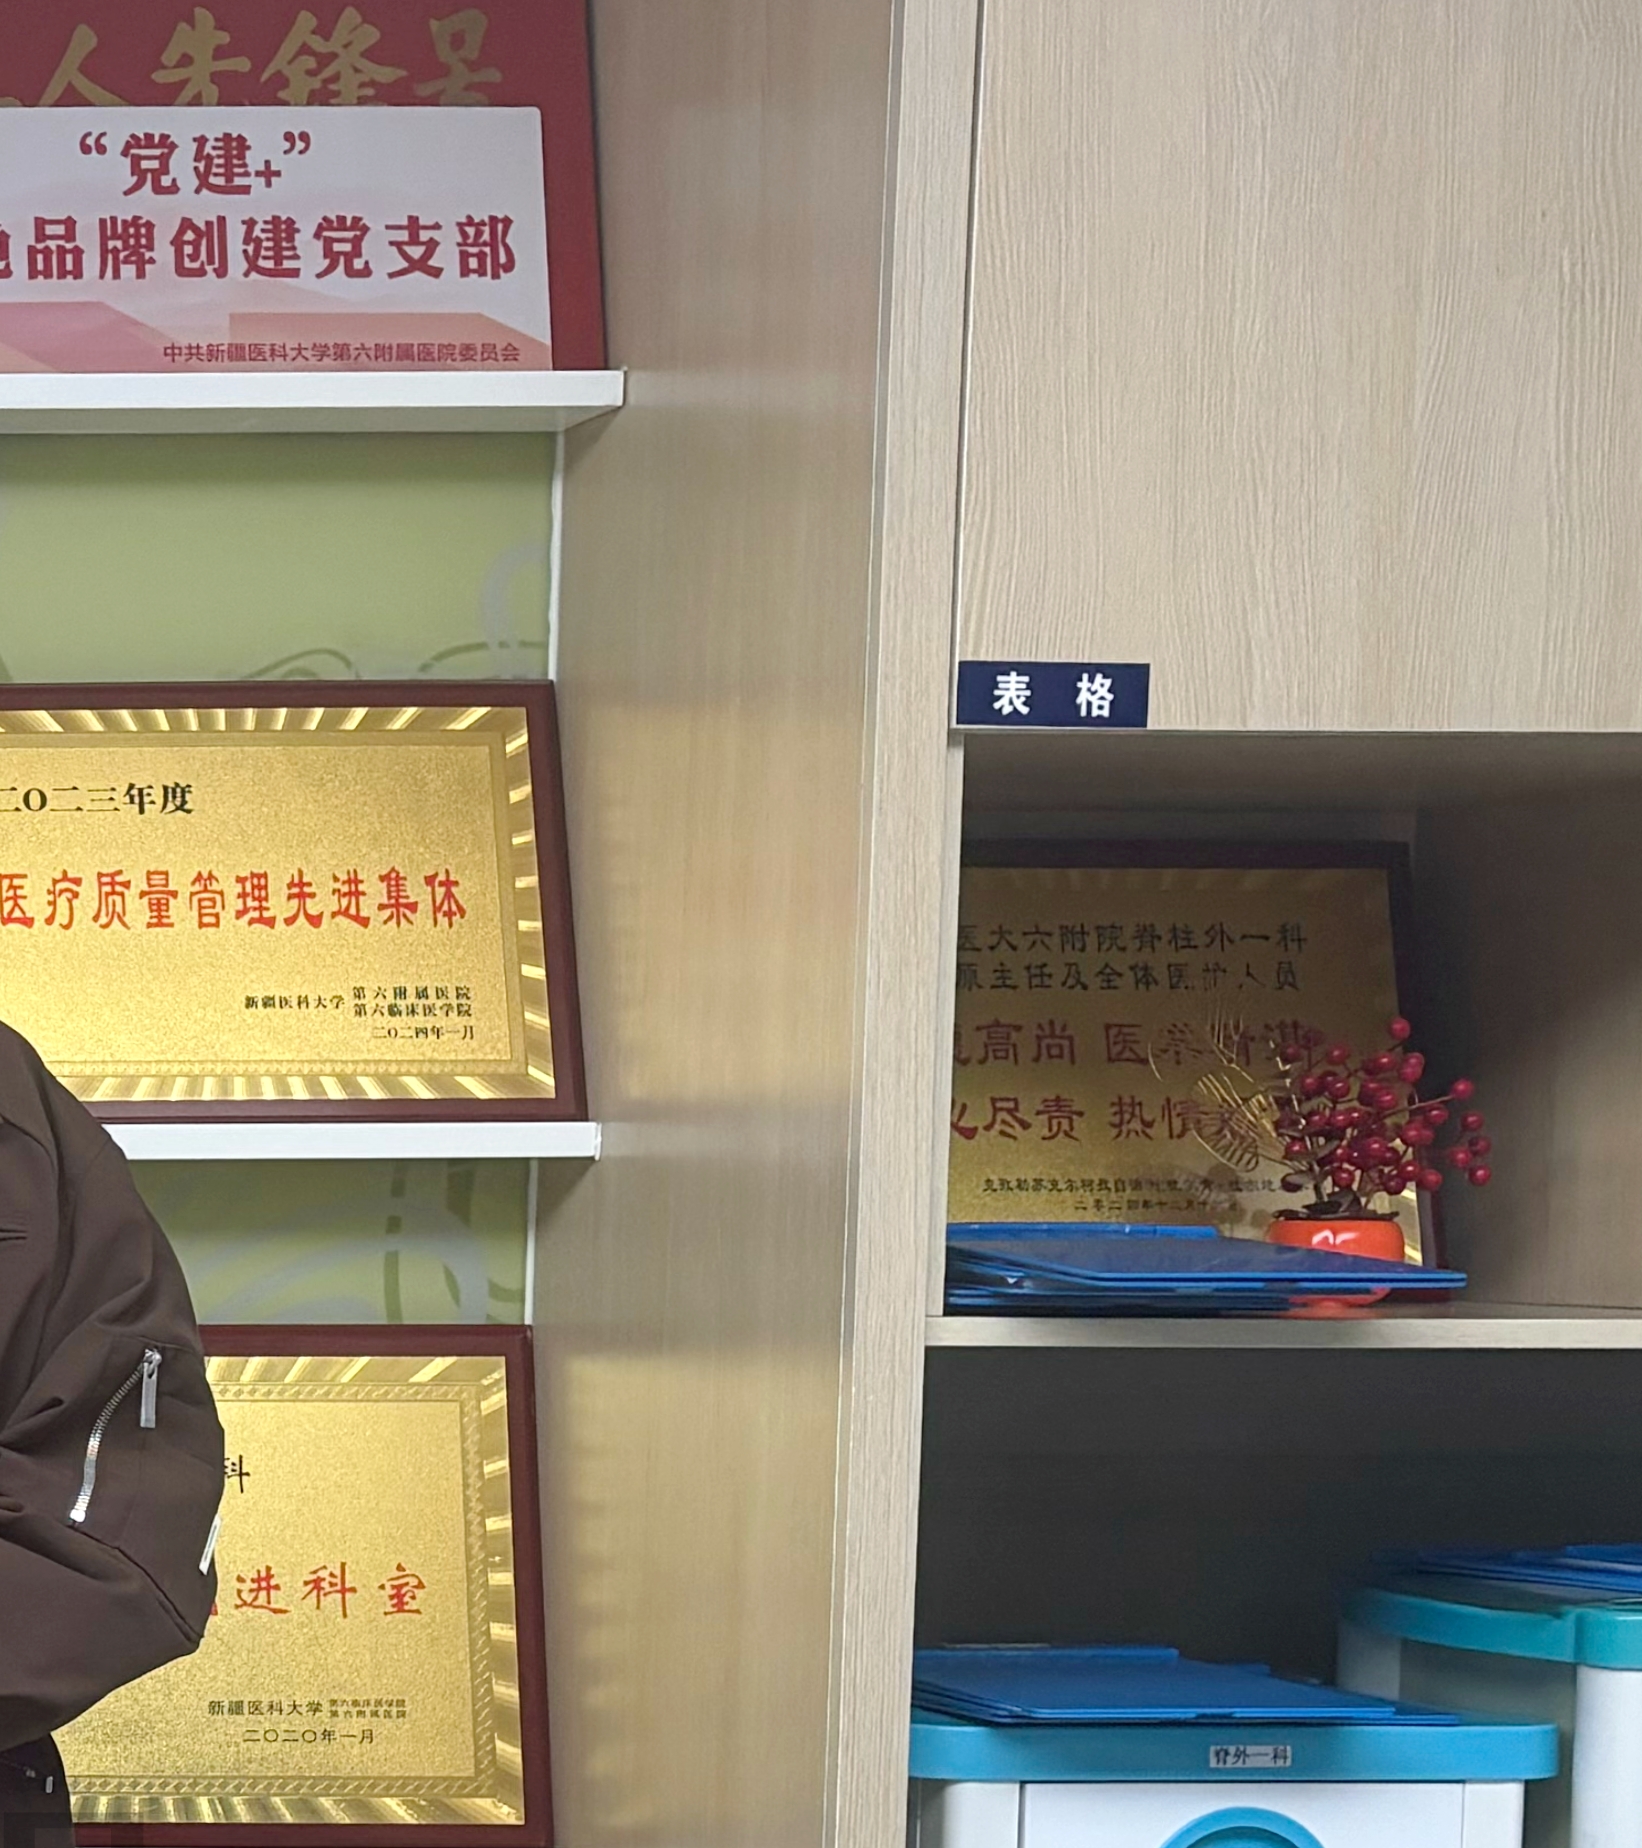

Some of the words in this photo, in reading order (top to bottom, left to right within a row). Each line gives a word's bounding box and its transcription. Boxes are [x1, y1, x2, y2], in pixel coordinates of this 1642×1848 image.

[163, 340, 521, 364] 中共新疆医科大学第六附属医院委员会
[244, 994, 346, 1010] 新疆医科大学
[208, 1699, 323, 1716] 新疆医科大学
